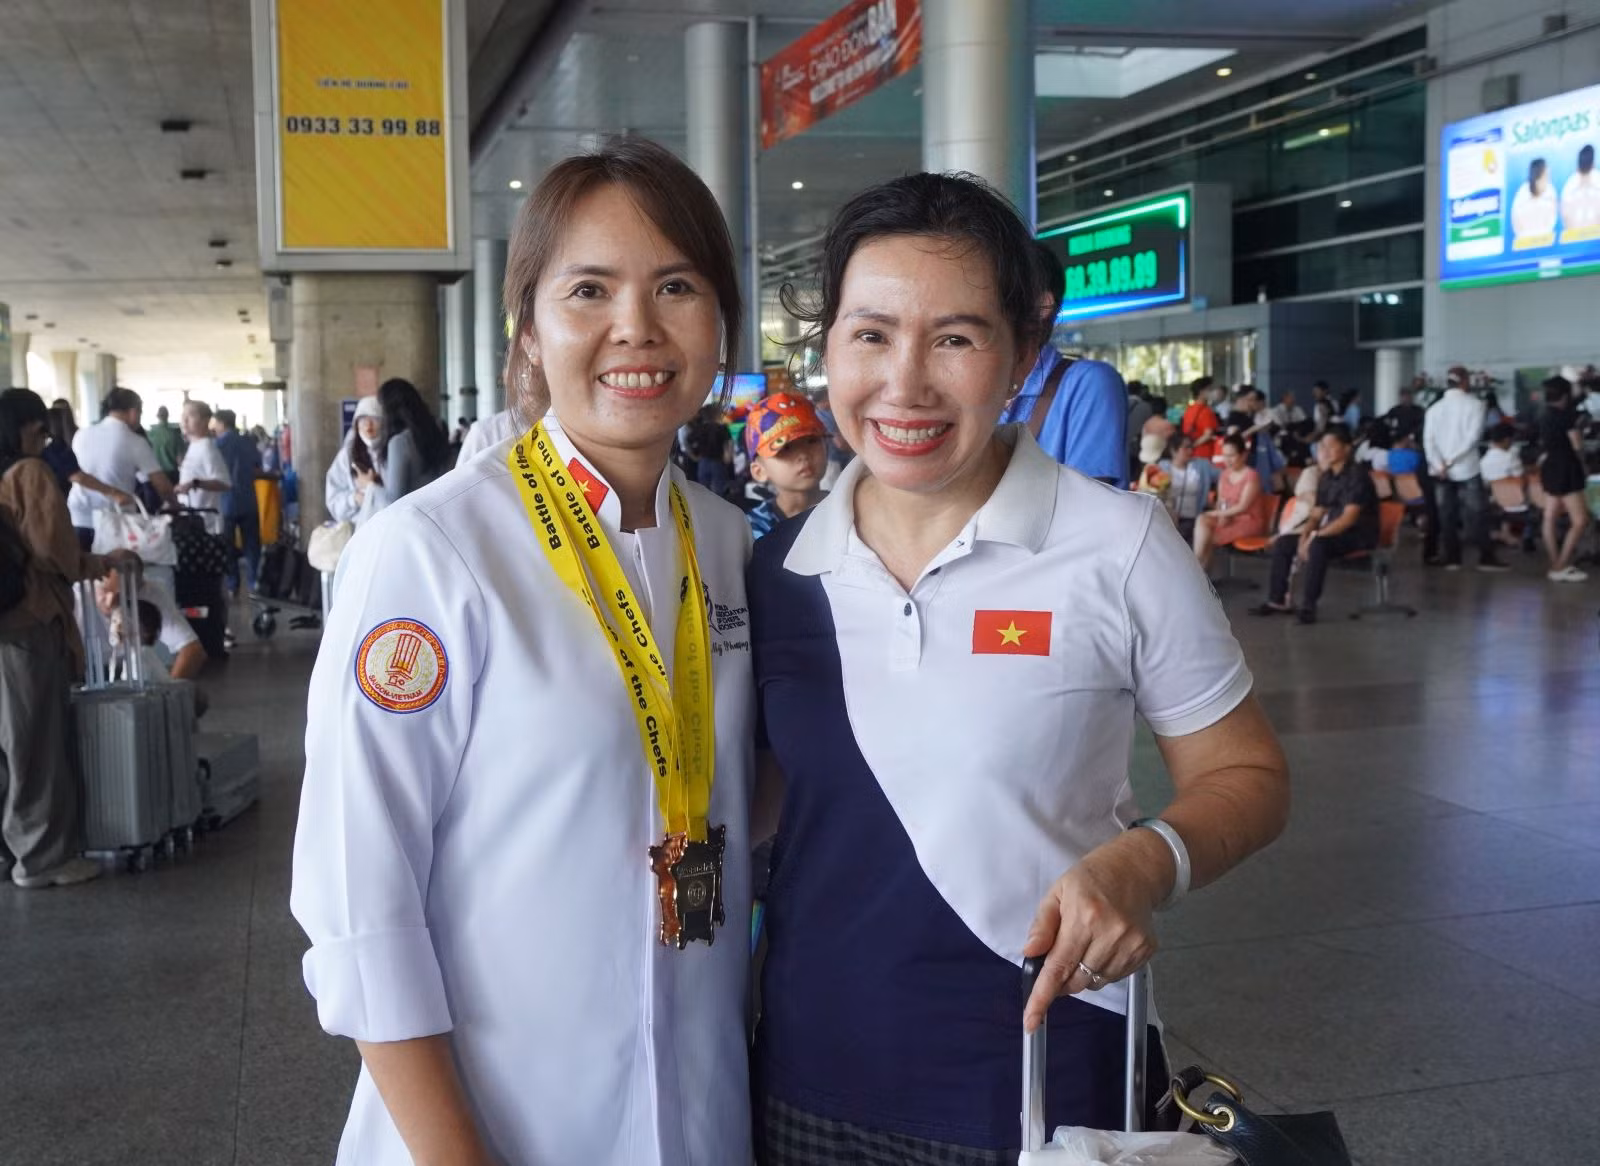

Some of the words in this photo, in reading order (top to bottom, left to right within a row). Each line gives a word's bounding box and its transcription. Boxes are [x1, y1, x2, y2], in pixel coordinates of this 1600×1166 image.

[286, 116, 341, 134] 0933
[348, 118, 374, 135] 33
[382, 119, 407, 135] 99
[416, 120, 441, 136] 88
[1512, 110, 1590, 145] Salonpas
[537, 440, 553, 467] the
[522, 472, 538, 489] of
[550, 469, 566, 487] of
[533, 493, 562, 551] Battle
[565, 491, 601, 550] Battle
[615, 588, 648, 648] Chefs
[619, 648, 635, 668] of
[631, 673, 648, 710] the
[645, 715, 668, 777] Chefs
